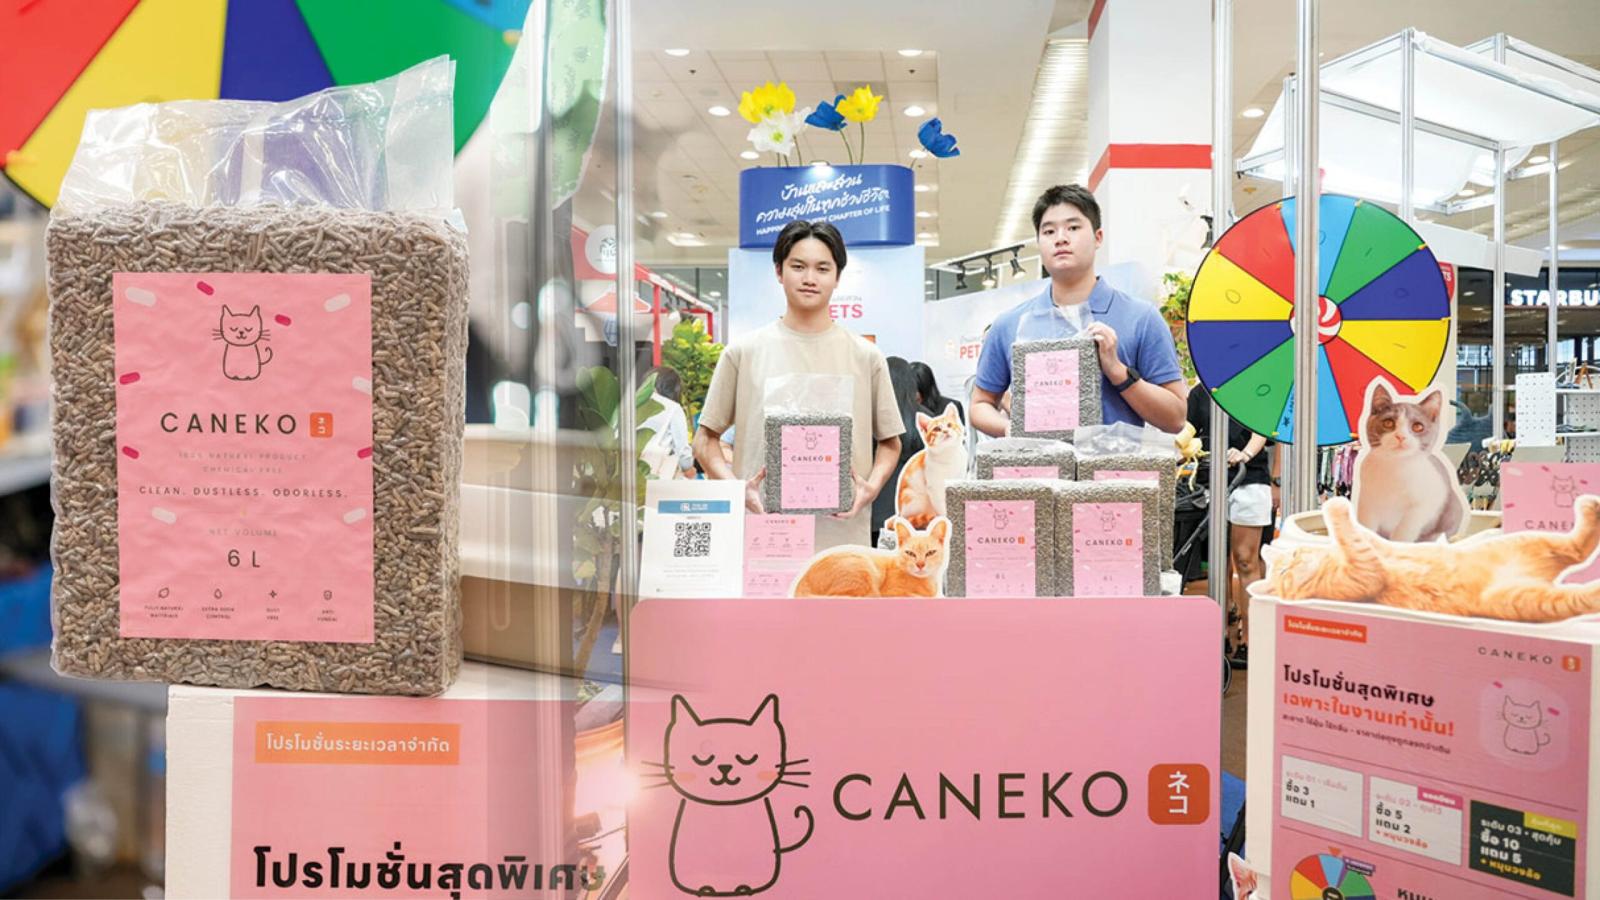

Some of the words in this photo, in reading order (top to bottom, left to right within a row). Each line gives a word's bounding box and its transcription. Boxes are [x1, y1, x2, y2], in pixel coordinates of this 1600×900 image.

[829, 209, 862, 222] CHAPTER
[863, 207, 874, 216] OF
[875, 204, 890, 214] LIFE
[829, 304, 863, 318] ETS
[160, 412, 297, 434] CANEKO
[791, 455, 824, 463] CANEKO
[138, 485, 187, 496] CLEAN.
[193, 487, 266, 497] DUSTLESS.
[272, 488, 349, 499] ODORLESS.
[227, 549, 241, 568] 6
[252, 551, 261, 568] L
[1478, 646, 1553, 665] CANEKO
[1284, 664, 1435, 708] โปรโมชั่นสุดพิเศษ
[1284, 692, 1455, 737] เฉพาะในงานเท่านั้น!
[267, 732, 451, 754] โปรโมชั่นระยะเวลาจำกัด
[832, 770, 1129, 822] CANEKO
[1167, 770, 1189, 816] ネコ
[1302, 786, 1310, 796] 3
[1310, 799, 1316, 809] 1
[1376, 801, 1392, 817] ซื้อ
[1395, 810, 1403, 820] 5
[1376, 818, 1400, 831] แถม
[1403, 824, 1411, 835] 2
[1480, 827, 1500, 846] ซื้อ
[1502, 837, 1520, 851] 10
[1480, 845, 1509, 861] แถม
[1511, 852, 1523, 865] 5
[253, 842, 607, 900] โปรโมชั่นสุดพิเศษ
